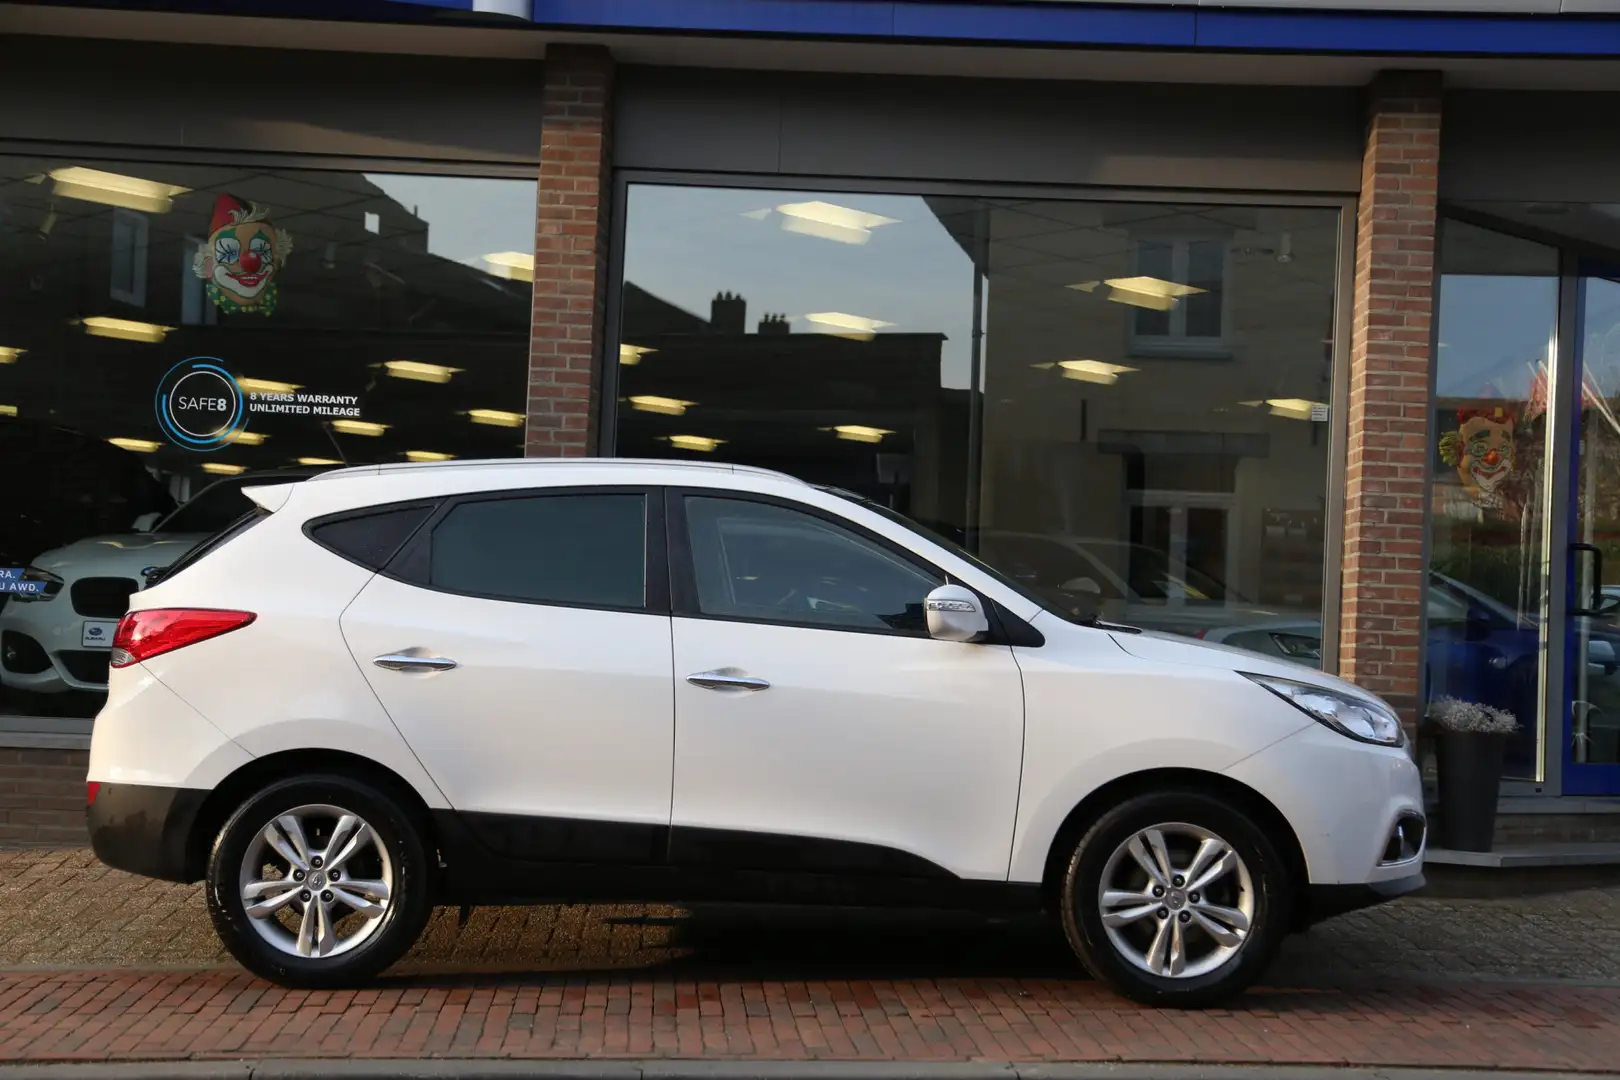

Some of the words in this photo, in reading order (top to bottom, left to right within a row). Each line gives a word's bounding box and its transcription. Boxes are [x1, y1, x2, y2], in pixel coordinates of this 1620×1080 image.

[178, 396, 227, 411] SAFE8
[249, 392, 257, 400] 8
[260, 392, 294, 402] YEARS
[297, 394, 358, 405] WARRANTY
[249, 403, 310, 414] UNLIMITED
[313, 406, 360, 416] MILEAGE
[9, 582, 39, 592] AWD.
